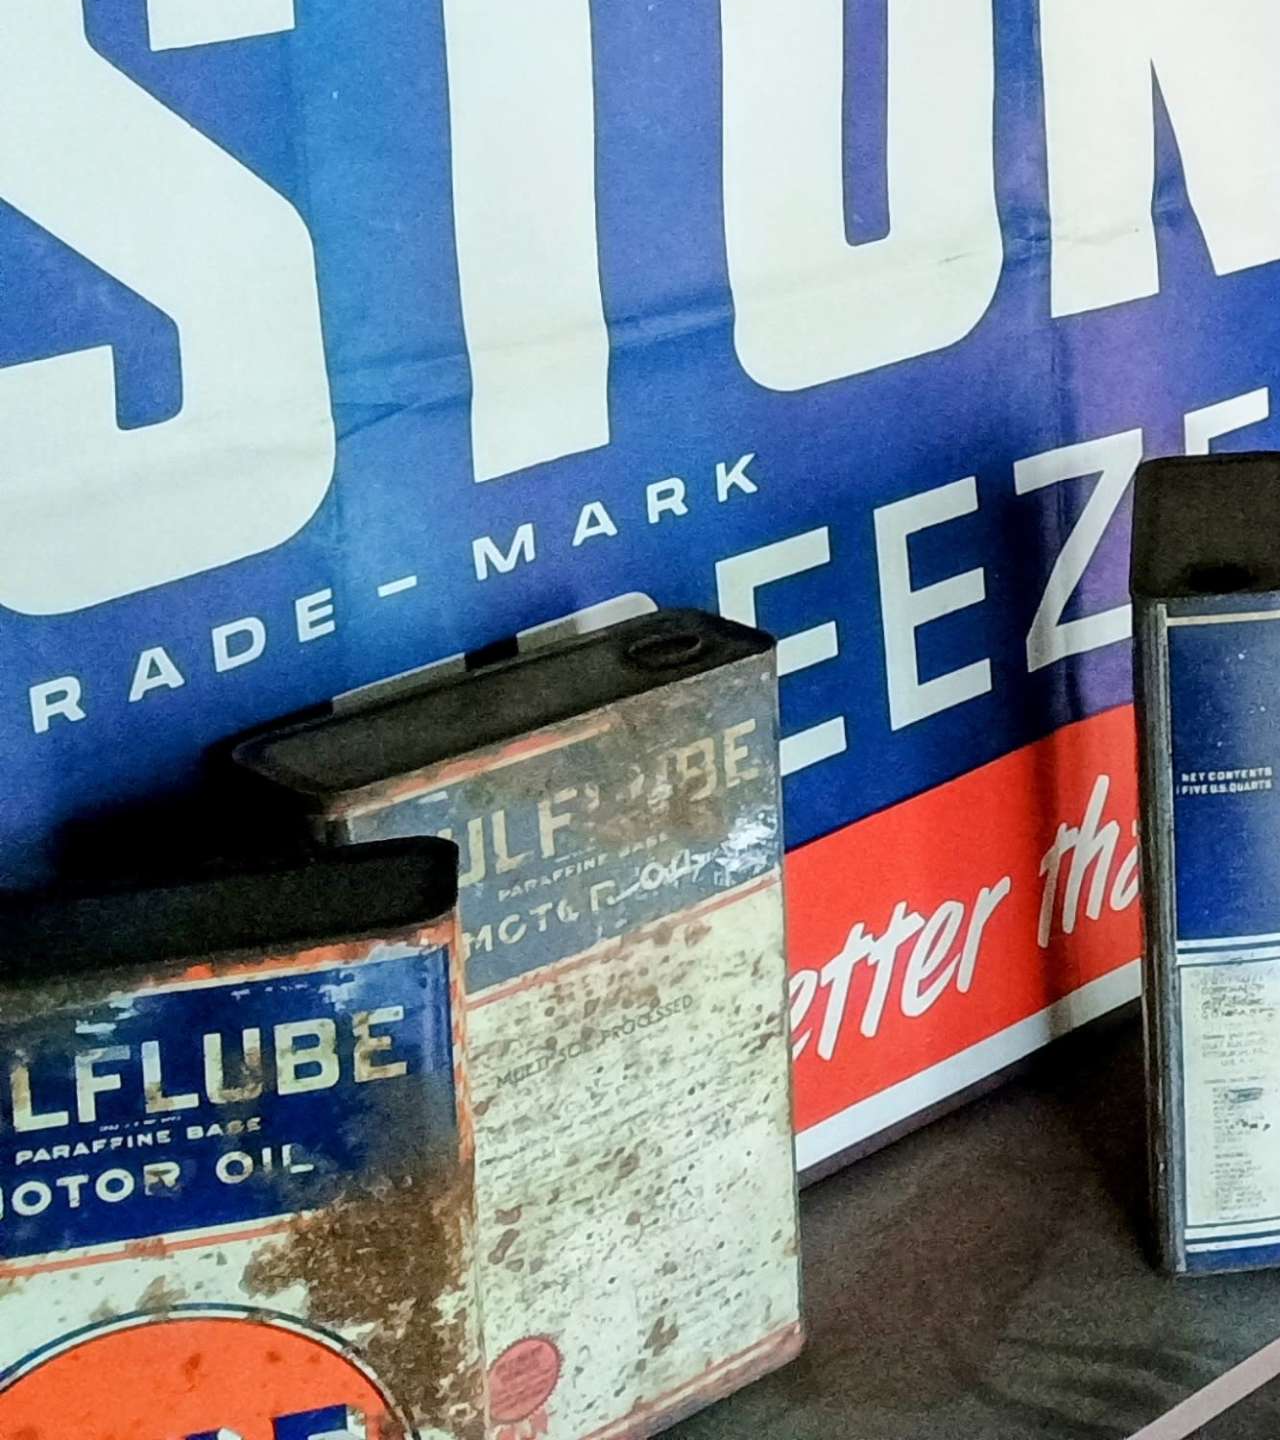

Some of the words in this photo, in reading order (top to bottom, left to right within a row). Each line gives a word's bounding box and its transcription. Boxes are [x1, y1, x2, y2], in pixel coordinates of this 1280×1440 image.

[515, 386, 1270, 777] EEZ
[1181, 784, 1208, 795] FIVE
[1228, 778, 1272, 794] QUARTS
[1207, 766, 1273, 782] CONTENTS
[789, 875, 1011, 1060] etter
[10, 1005, 408, 1134] LFLUBE
[14, 1129, 172, 1167] PARAFFINE
[186, 1116, 263, 1141] BASE
[0, 1160, 181, 1222] OTOR
[214, 1143, 316, 1185] OIL
